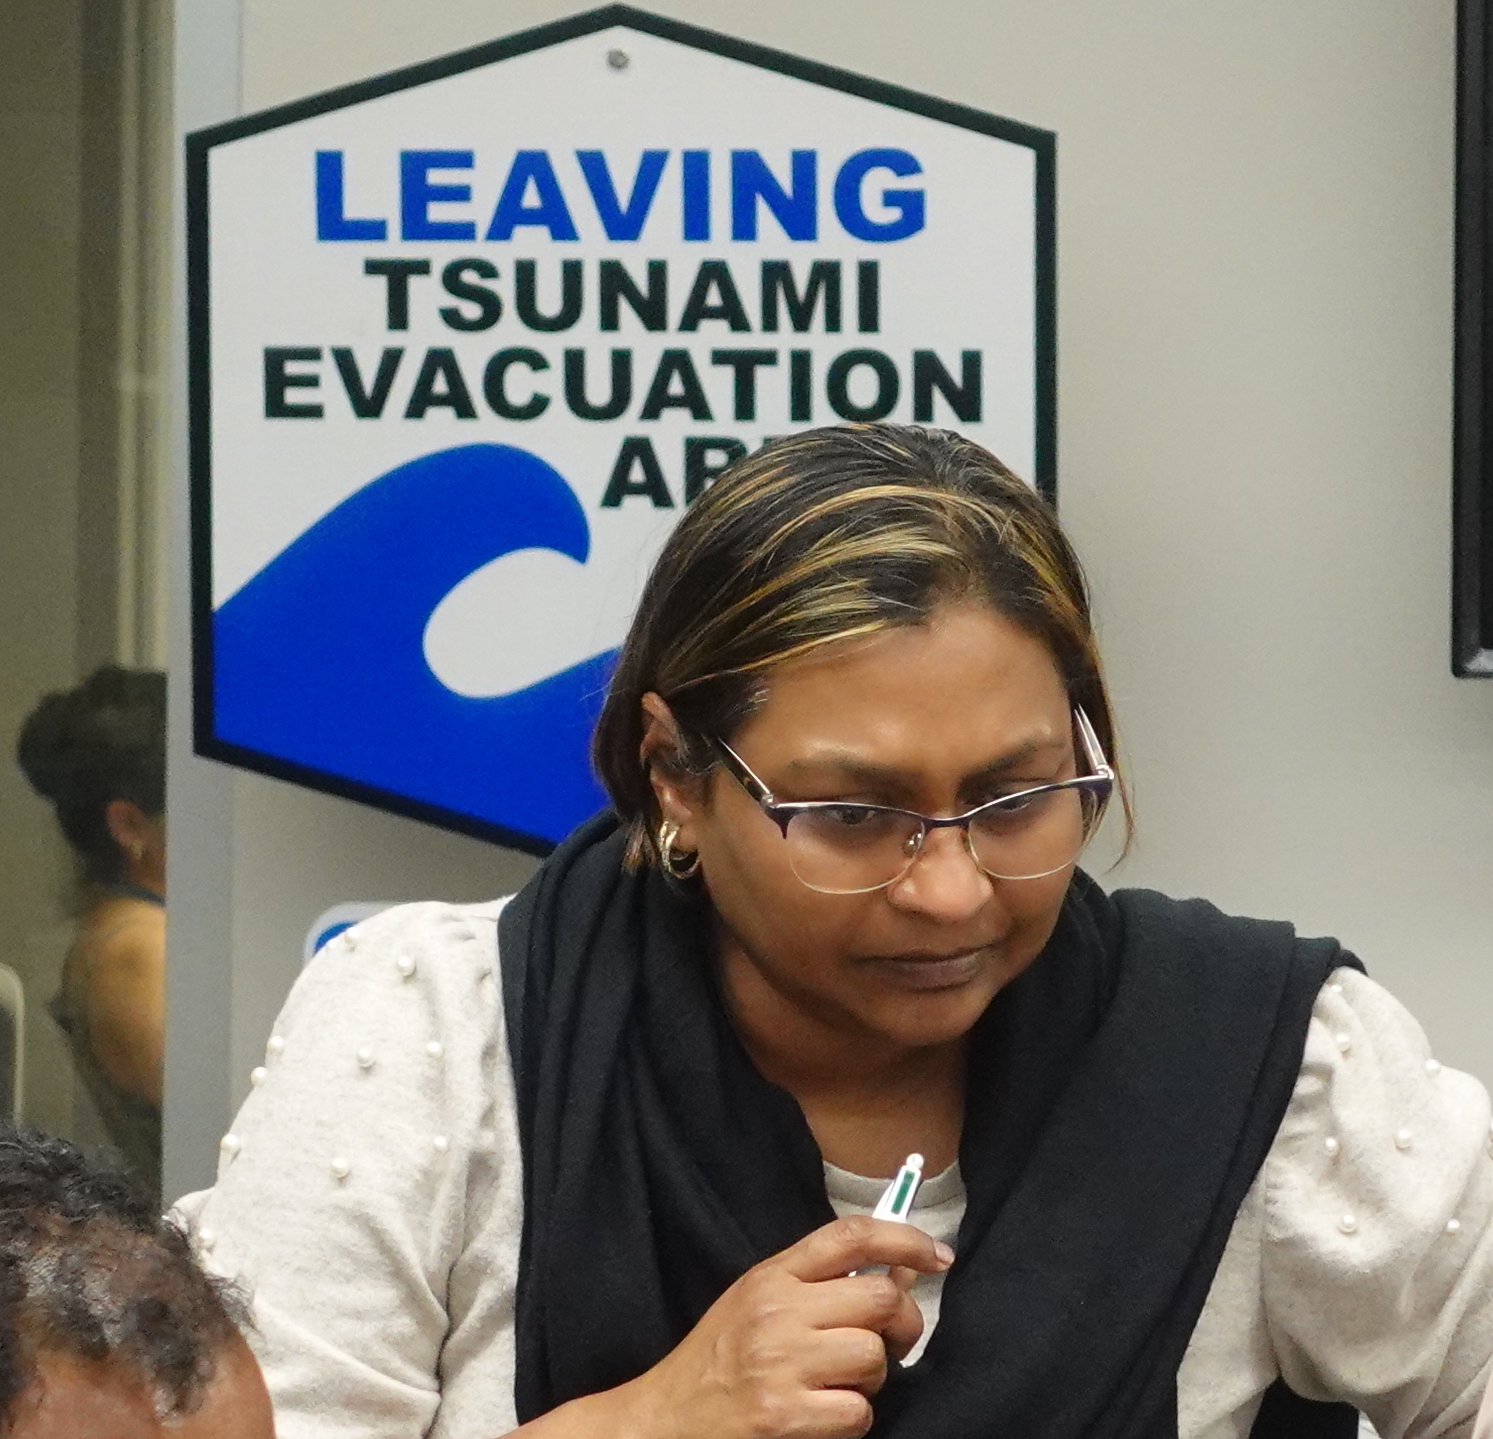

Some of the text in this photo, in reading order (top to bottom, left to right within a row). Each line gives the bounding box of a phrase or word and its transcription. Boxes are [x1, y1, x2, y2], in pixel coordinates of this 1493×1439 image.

[314, 148, 926, 243] LEAVING
[364, 258, 881, 334] TSUNAMI
[263, 347, 983, 425] EVACUATION
[600, 435, 778, 509] AR
